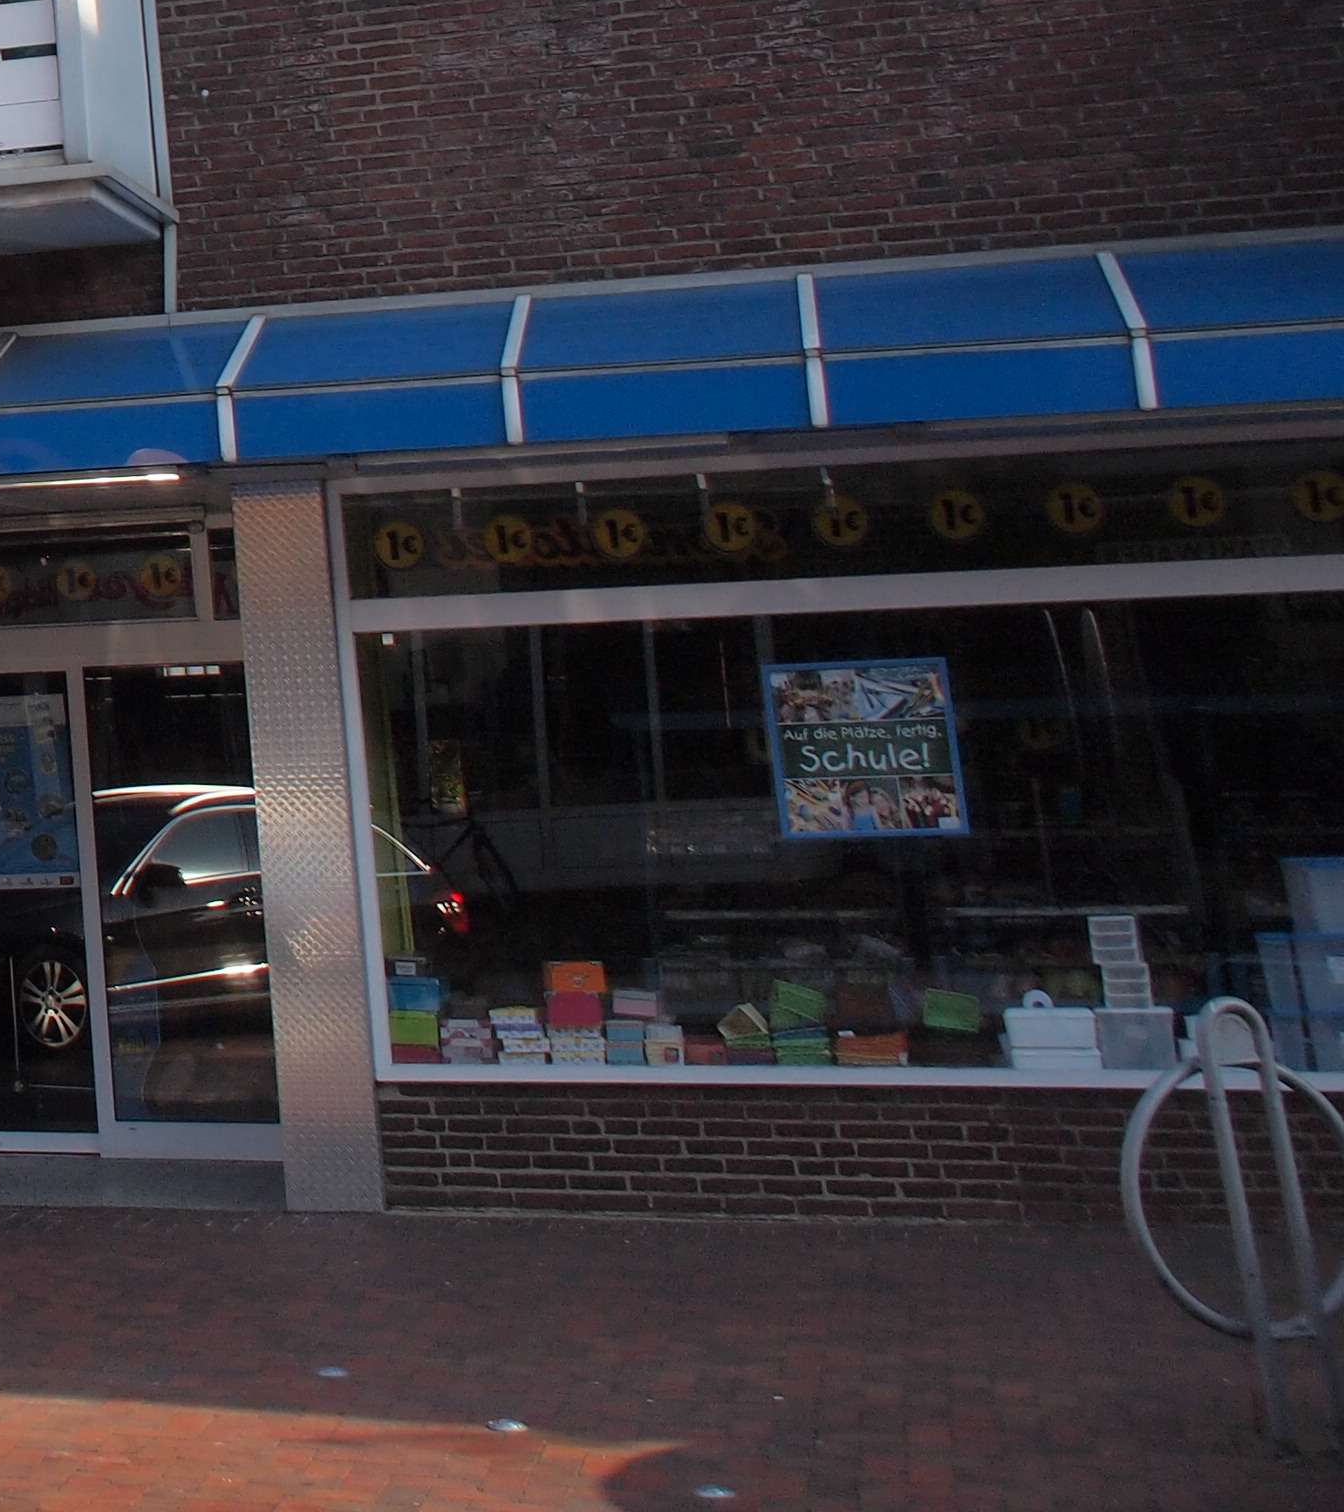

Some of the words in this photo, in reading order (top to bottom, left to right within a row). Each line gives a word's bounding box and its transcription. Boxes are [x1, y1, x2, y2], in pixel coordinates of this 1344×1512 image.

[784, 728, 809, 741] Auf
[813, 727, 838, 740] die
[800, 742, 931, 772] Schule!
